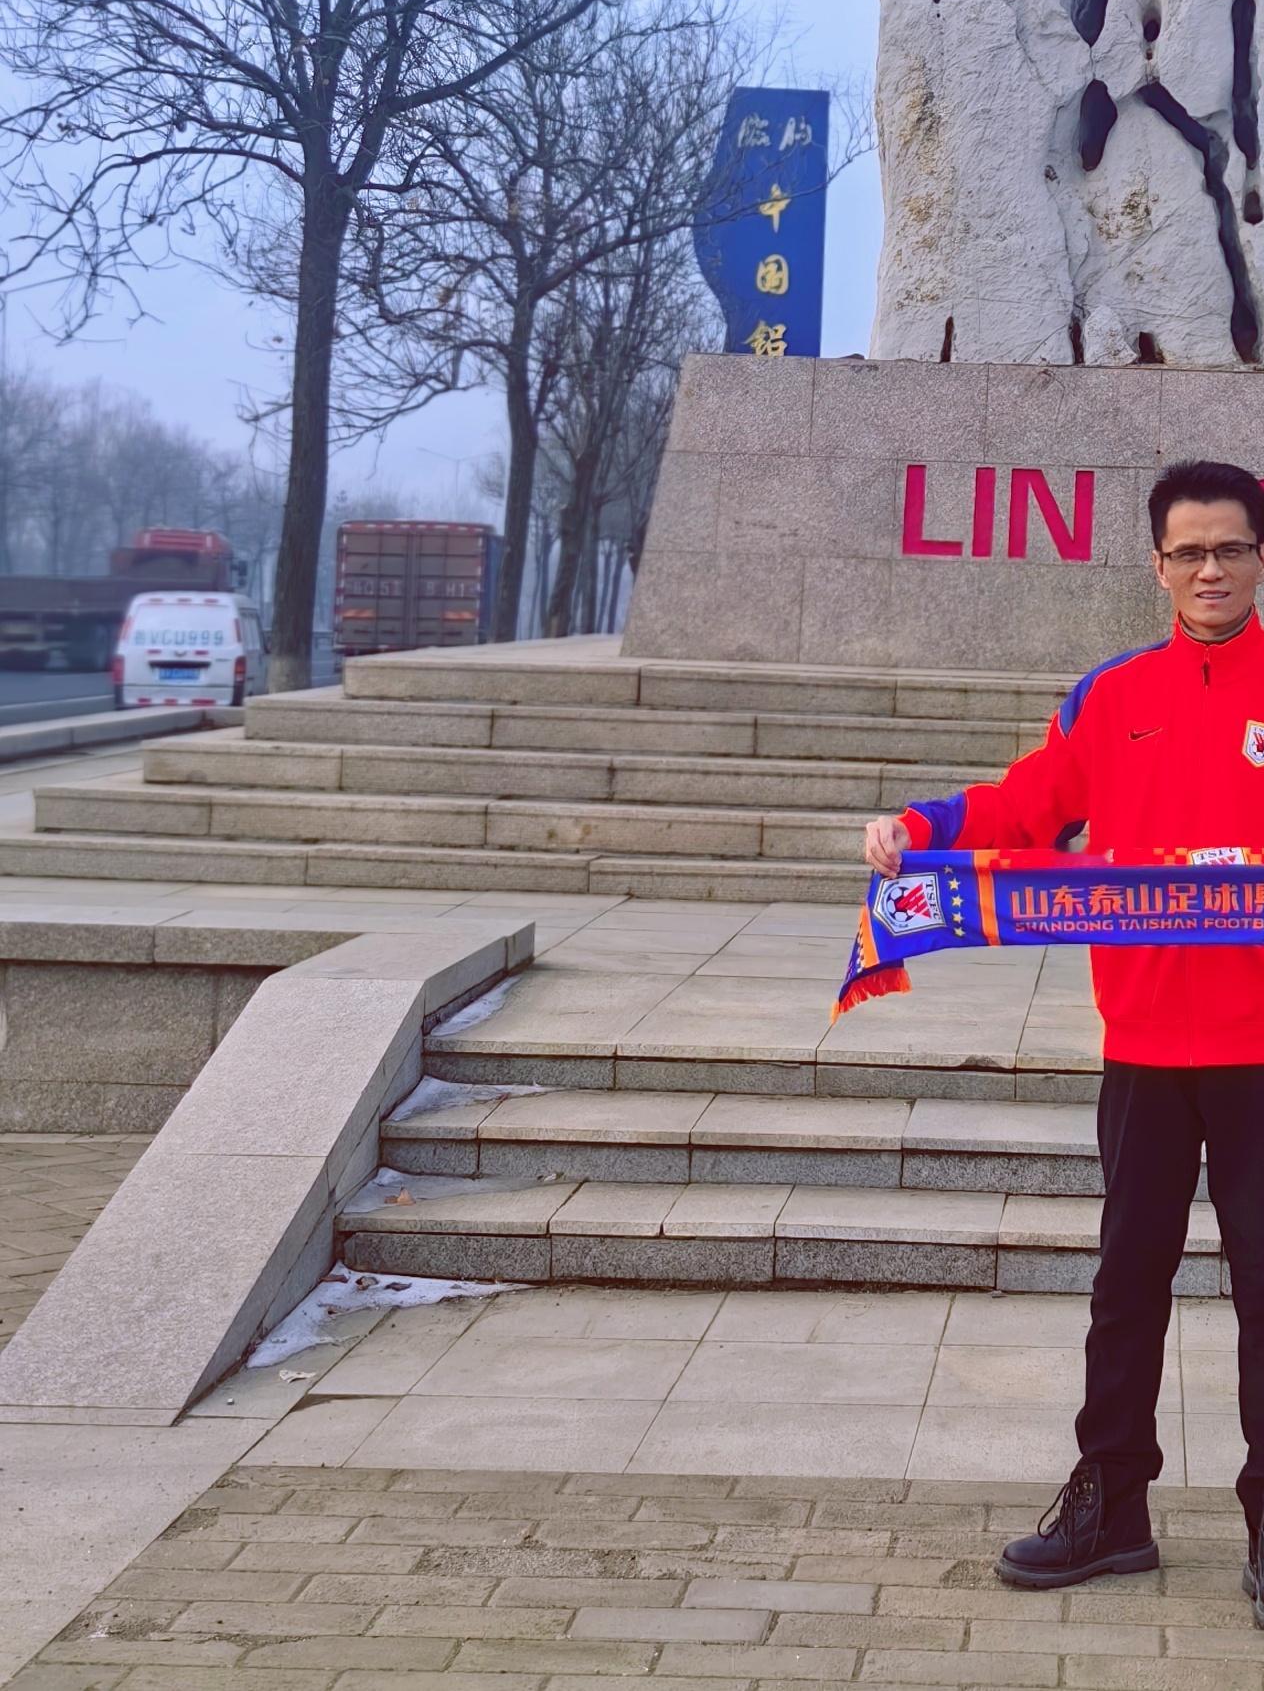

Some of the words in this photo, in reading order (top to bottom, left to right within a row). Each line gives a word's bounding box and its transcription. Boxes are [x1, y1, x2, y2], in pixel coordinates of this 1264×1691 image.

[902, 464, 1095, 562] LIN
[925, 879, 941, 920] TSFC
[1015, 918, 1114, 933] SHANDONG
[1118, 918, 1197, 931] TAISHAN
